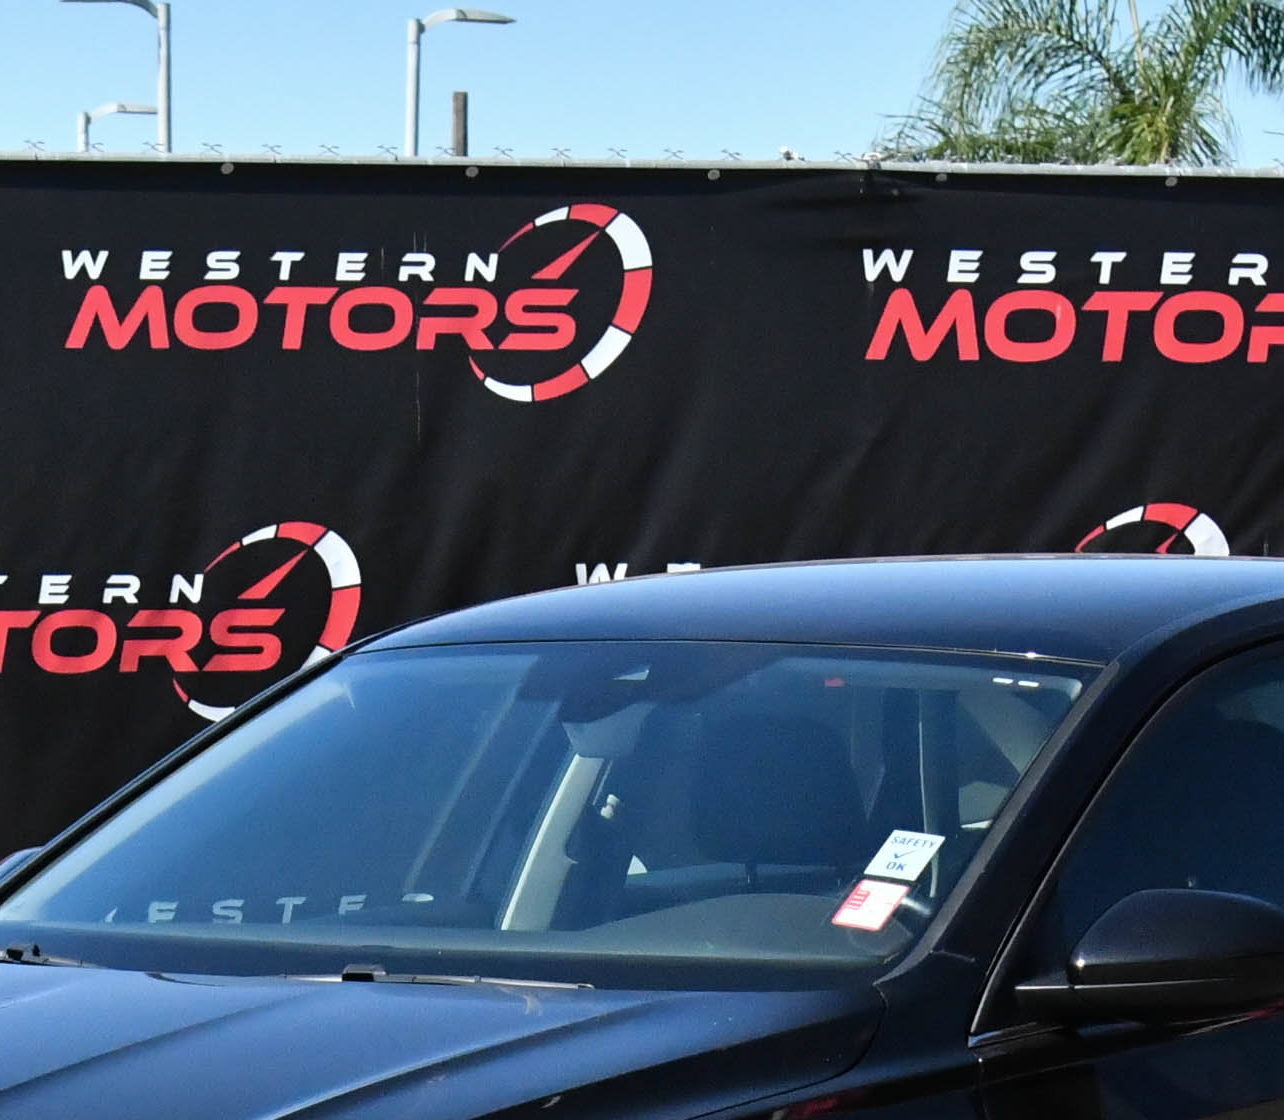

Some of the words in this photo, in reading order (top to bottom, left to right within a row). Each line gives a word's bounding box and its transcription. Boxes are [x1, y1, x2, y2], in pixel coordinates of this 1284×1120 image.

[62, 250, 498, 282] WESTERN
[66, 285, 577, 350] MOTORS
[891, 836, 938, 849] SAFETY
[885, 861, 908, 872] OK
